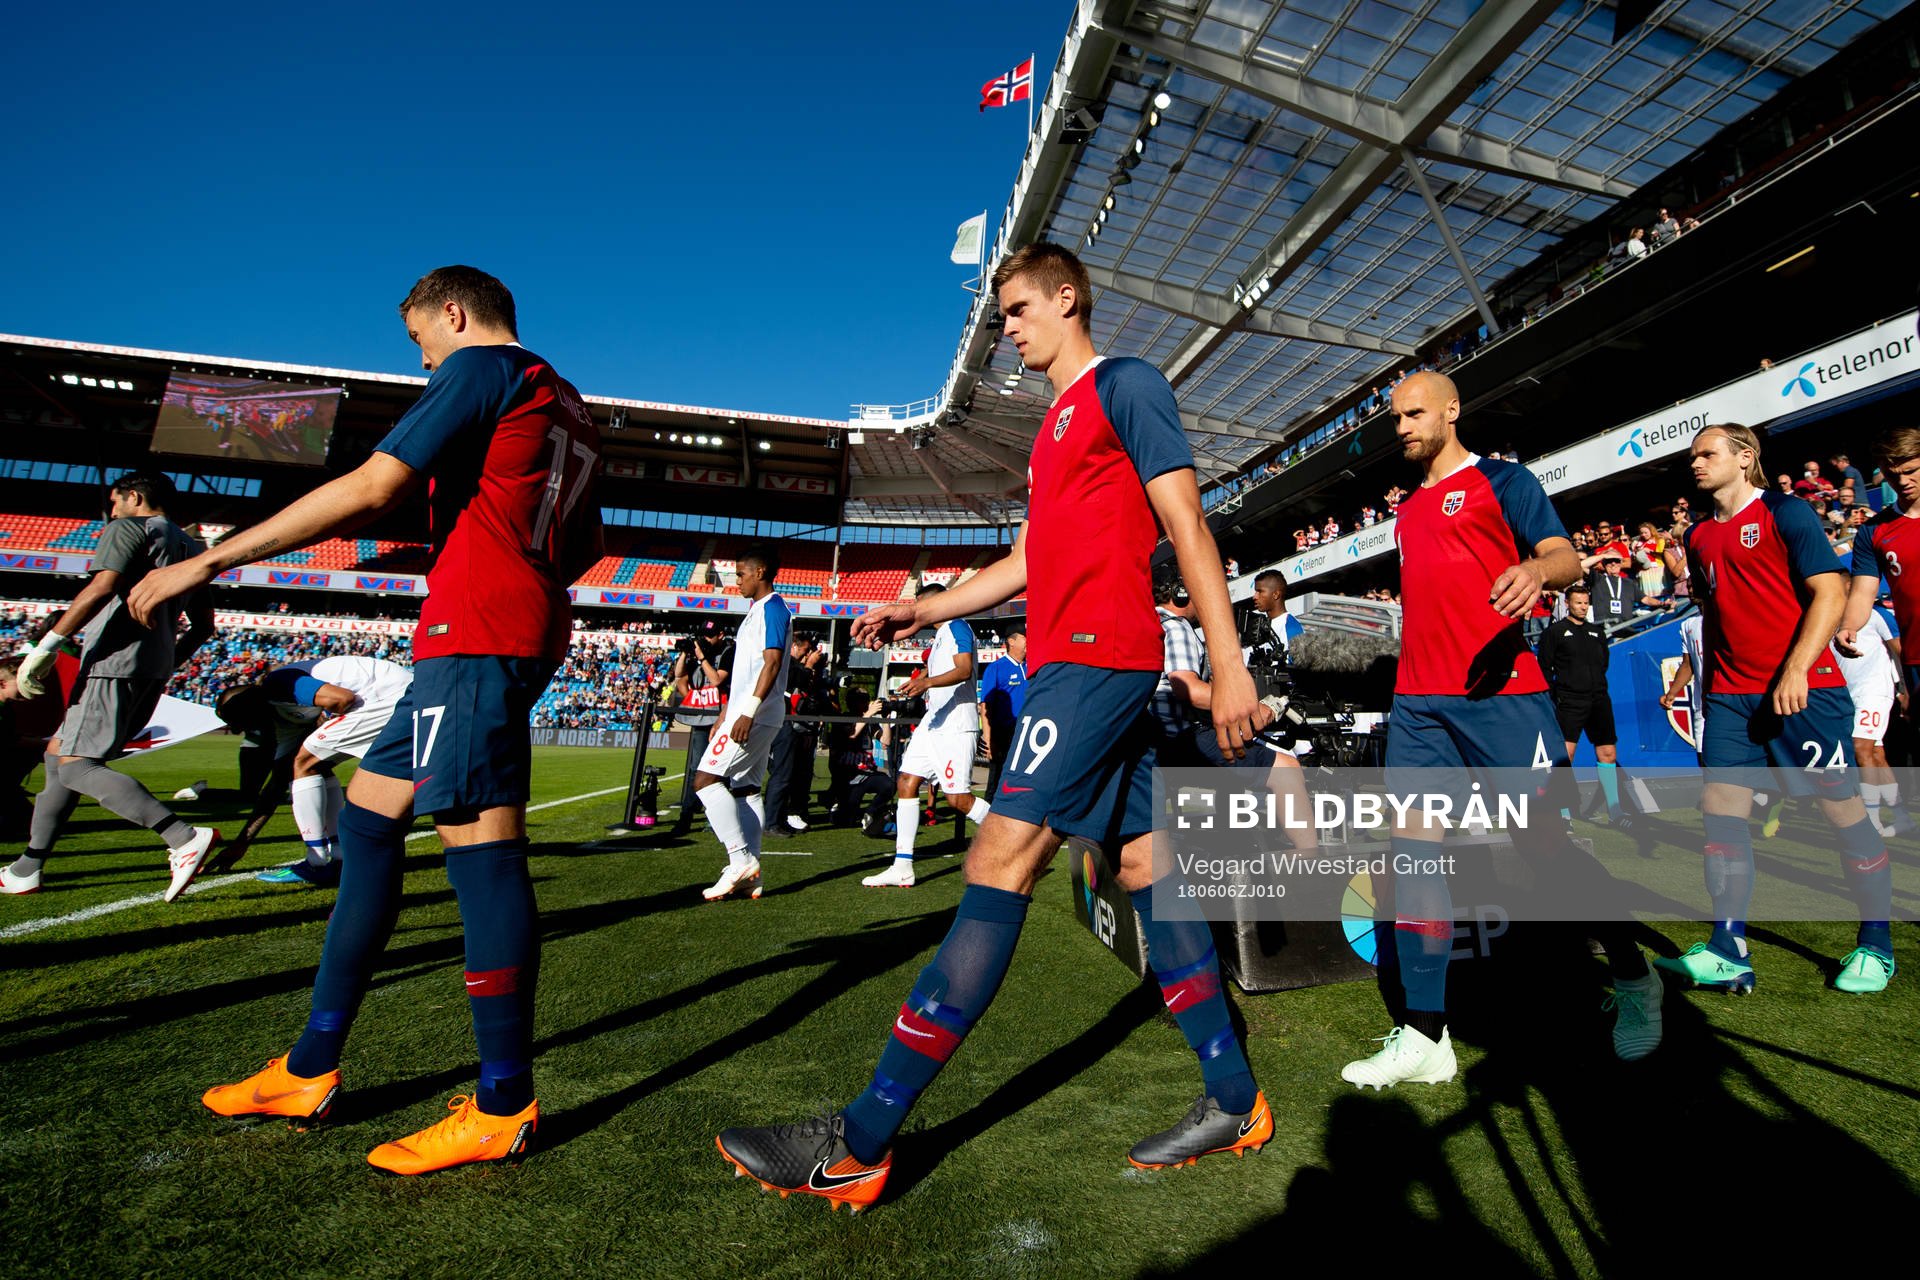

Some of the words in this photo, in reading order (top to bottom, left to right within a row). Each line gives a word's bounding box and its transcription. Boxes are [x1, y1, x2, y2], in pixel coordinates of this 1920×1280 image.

[1816, 335, 1914, 385] telenor
[1643, 411, 1709, 448] telenor
[676, 466, 738, 486] VG
[768, 475, 828, 494] VG
[1538, 465, 1568, 486] enor
[530, 424, 598, 551] 17
[1358, 532, 1387, 552] telenor
[0, 554, 54, 570] VG
[1302, 554, 1326, 572] telenor
[1885, 550, 1902, 577] 3
[270, 571, 329, 587] VG
[357, 576, 414, 592] VG
[601, 591, 653, 606] VG
[677, 596, 727, 610] VG
[254, 616, 294, 627] VG
[303, 619, 342, 630] VG
[352, 622, 391, 633] VG
[1860, 709, 1881, 728] 20
[413, 705, 446, 769] 17
[557, 730, 605, 748] NORGE
[614, 732, 670, 749] PANMA
[712, 734, 728, 756] 8
[1009, 715, 1058, 775] 19
[1531, 731, 1553, 774] 4
[1802, 739, 1849, 774] 24
[944, 759, 954, 780] 6
[1092, 891, 1116, 950] NEP
[1450, 904, 1512, 961] EP
